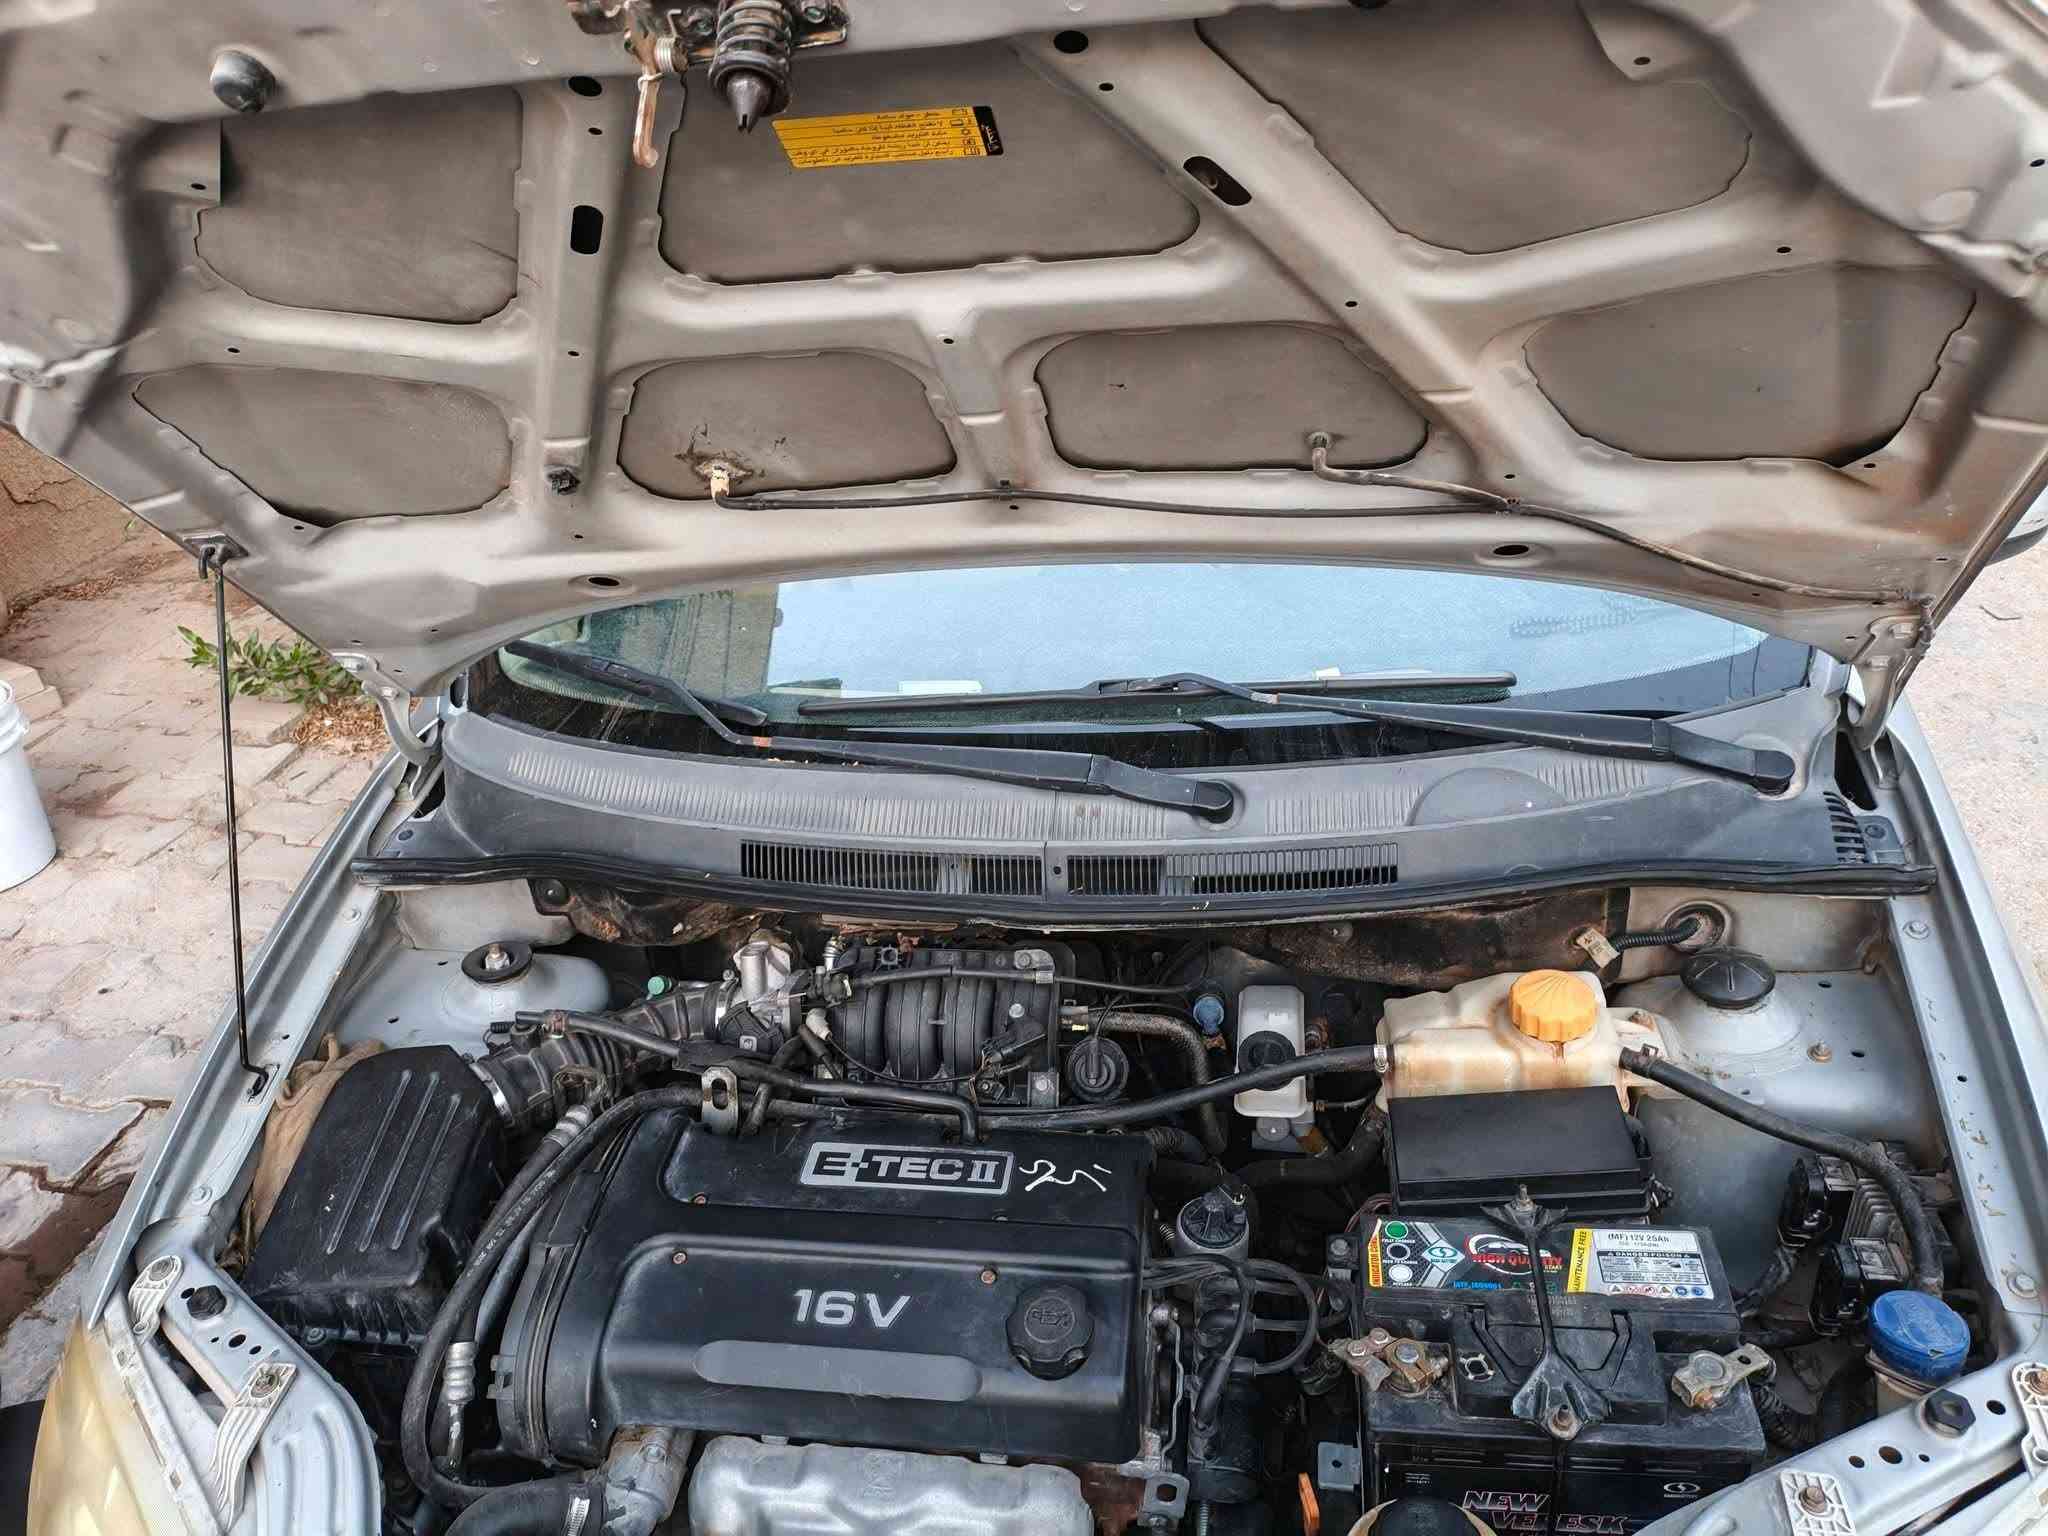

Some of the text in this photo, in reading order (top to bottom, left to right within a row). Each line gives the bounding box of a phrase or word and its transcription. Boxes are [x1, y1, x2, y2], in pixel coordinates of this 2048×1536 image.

[812, 1152, 964, 1181] E-TEC
[1508, 1253, 1564, 1266] QUITY
[1463, 1490, 1549, 1512] NEW
